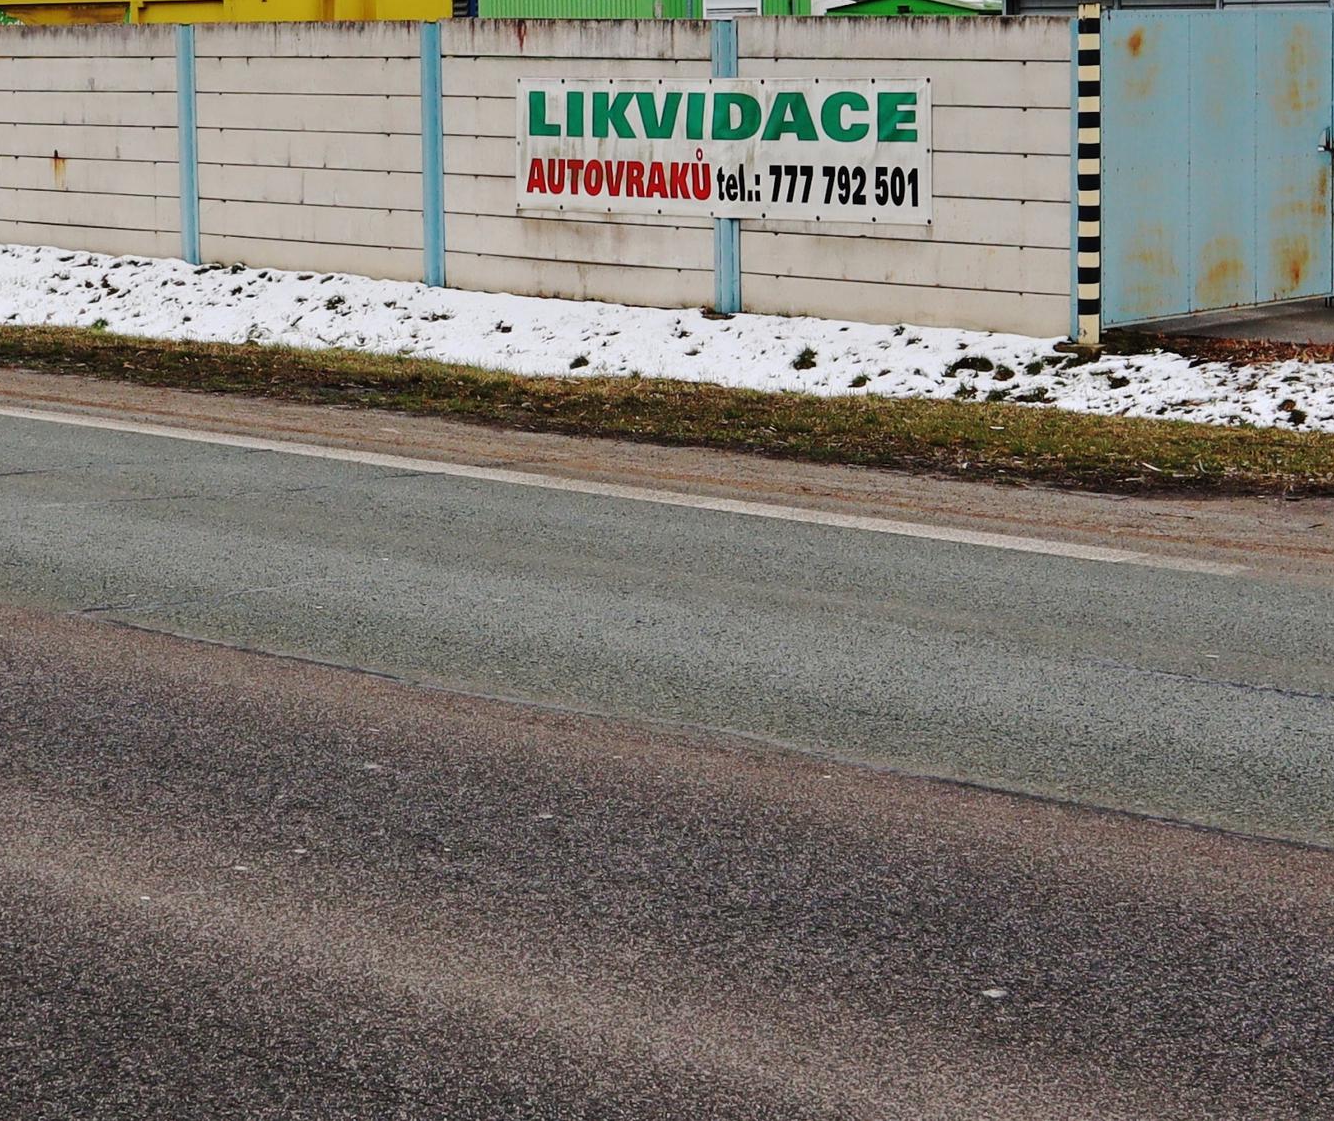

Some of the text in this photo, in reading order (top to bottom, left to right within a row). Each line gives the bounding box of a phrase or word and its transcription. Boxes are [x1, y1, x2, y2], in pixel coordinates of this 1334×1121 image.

[529, 91, 918, 143] LIKVIDACE
[526, 148, 919, 208] AUTOVRAKŮ tel.: 777 792 501
